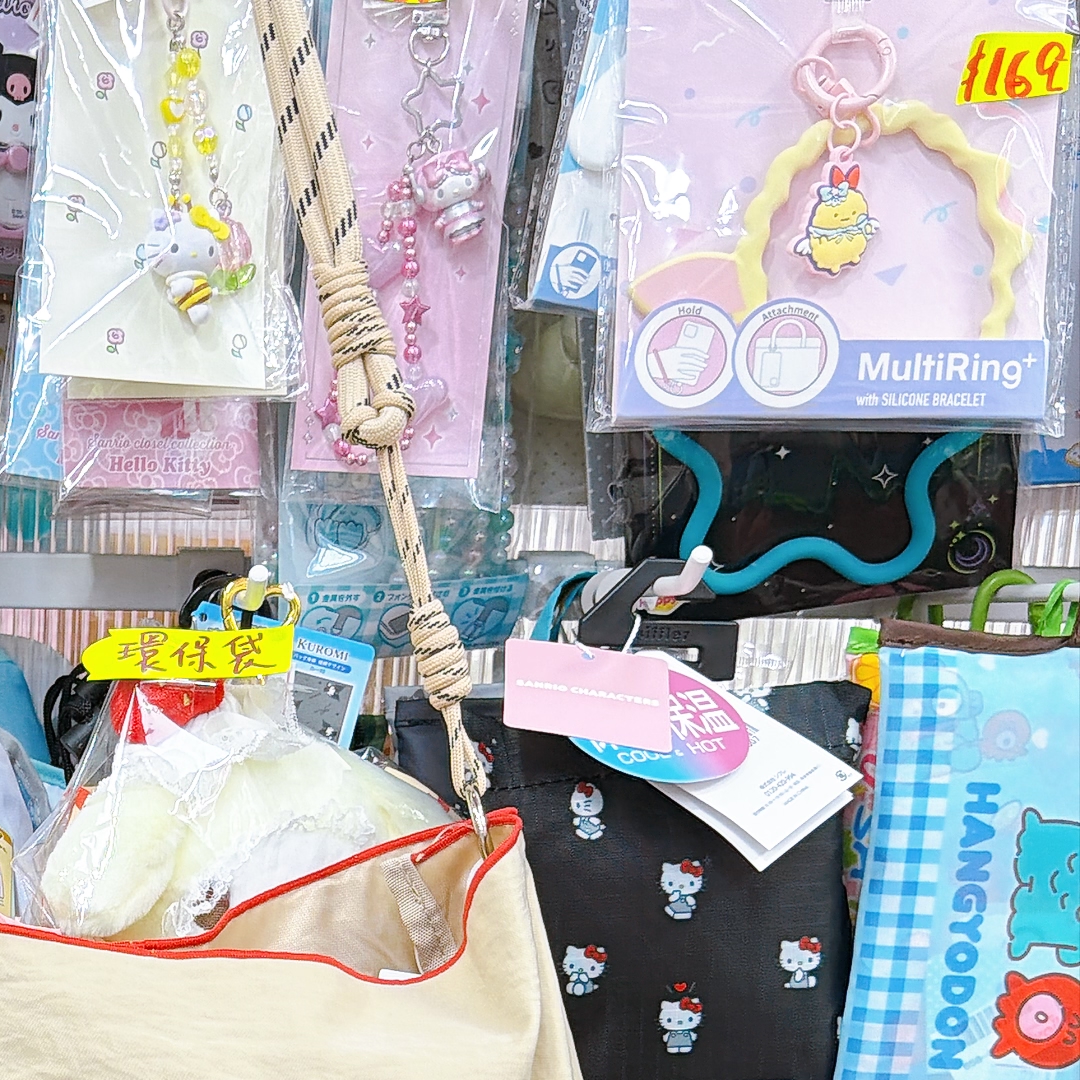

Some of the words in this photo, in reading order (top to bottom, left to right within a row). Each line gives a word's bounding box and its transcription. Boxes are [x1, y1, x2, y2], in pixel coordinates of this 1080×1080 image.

[961, 40, 1068, 101] $169
[677, 306, 703, 316] Hold
[761, 305, 820, 324] Attachment
[856, 393, 878, 407] with
[881, 393, 930, 407] SILICONE
[932, 394, 986, 407] BRACELET
[87, 431, 130, 450] Sanrio
[108, 454, 157, 474] Hello
[162, 456, 212, 477] Kitty
[117, 631, 277, 675] 環保袋
[297, 638, 350, 661] KUROMI
[515, 678, 569, 693] SANRIO
[686, 737, 727, 756] HOT
[928, 782, 1002, 1070] HANGYODON
